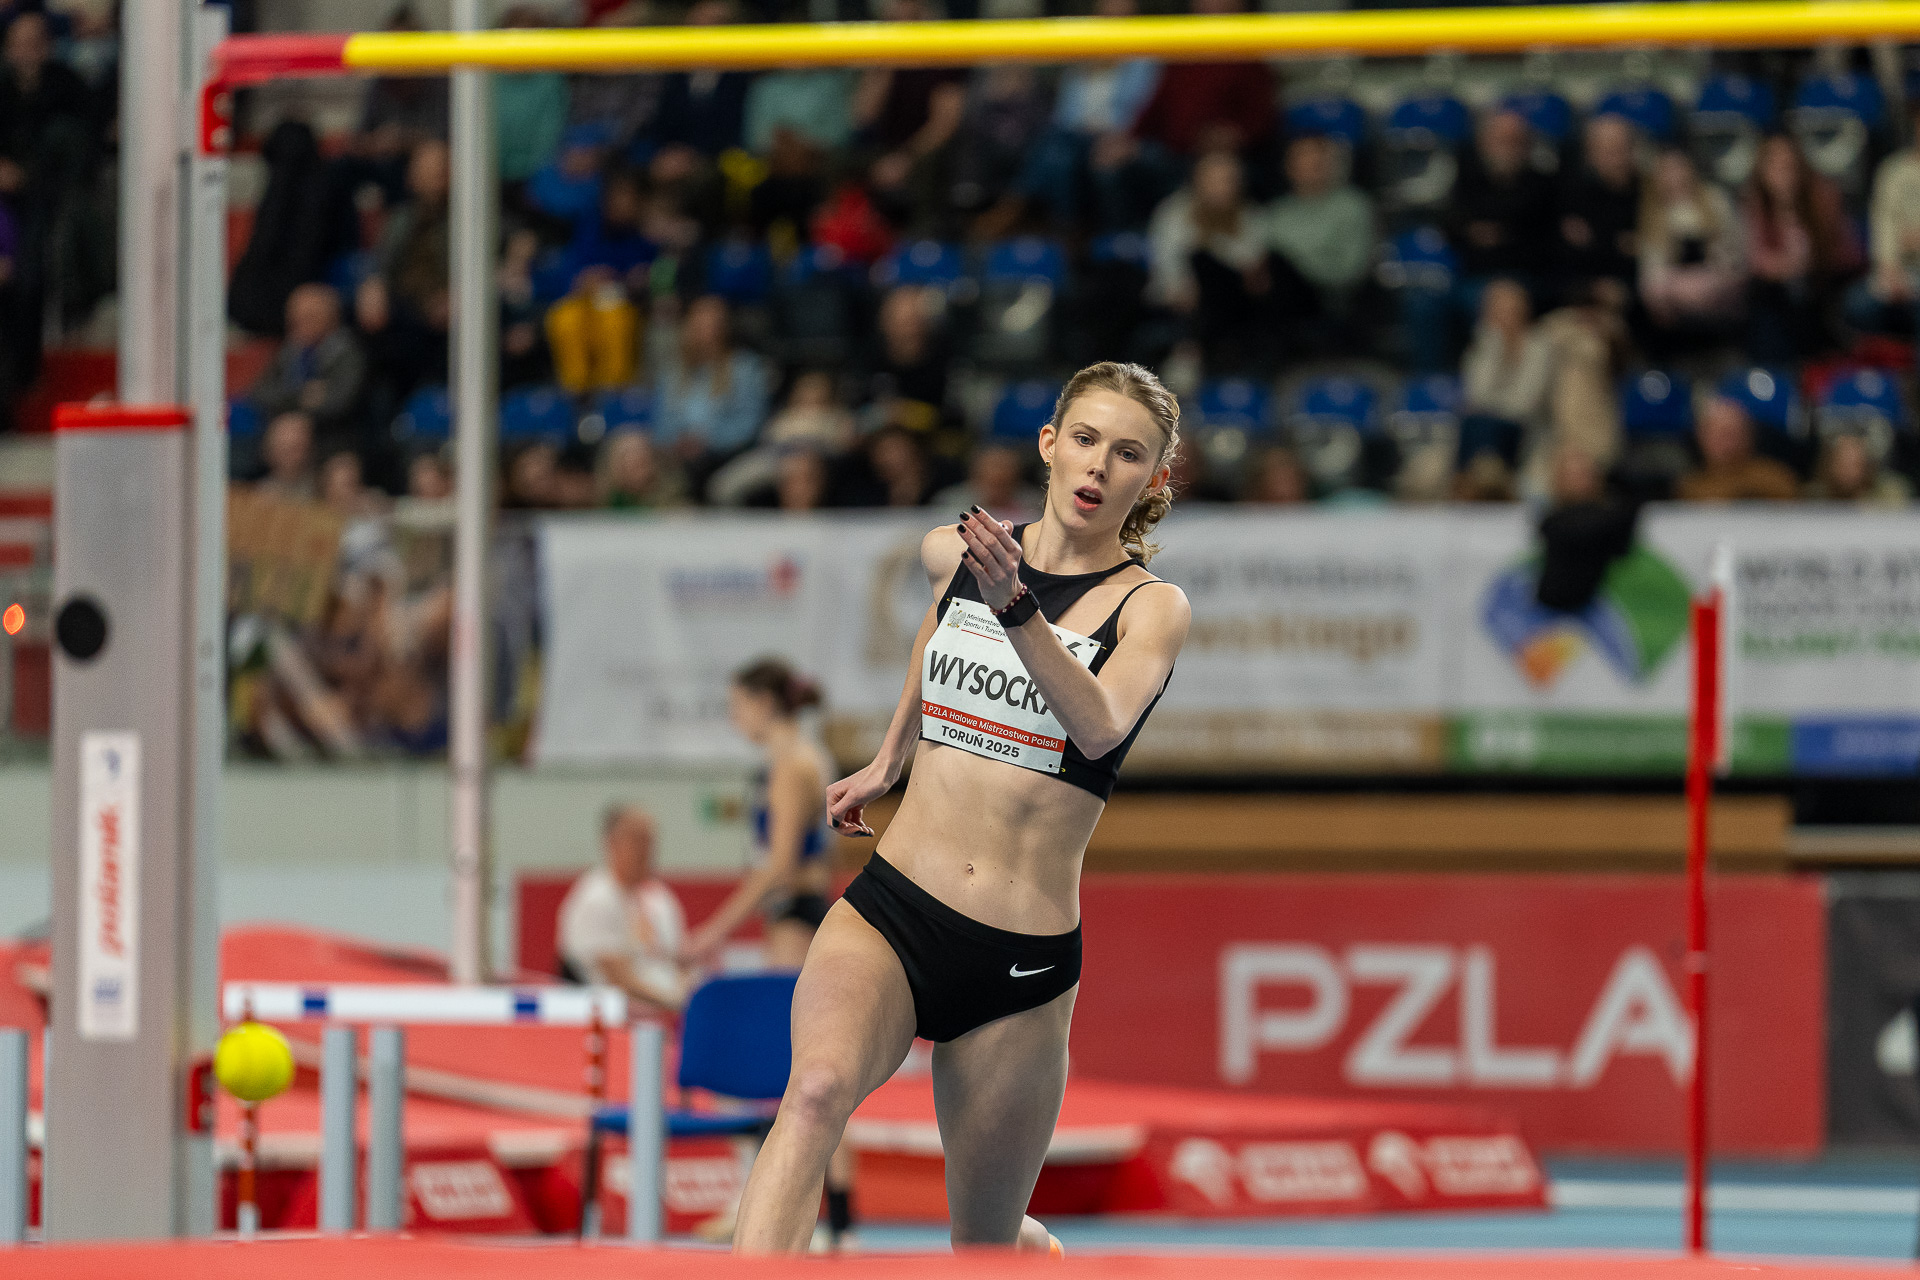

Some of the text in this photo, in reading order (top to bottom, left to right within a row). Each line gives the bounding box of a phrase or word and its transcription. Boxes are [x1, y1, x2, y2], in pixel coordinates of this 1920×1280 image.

[963, 619, 981, 631] Sportu
[966, 613, 1001, 628] Ministerstwo
[928, 650, 1050, 716] WYSOCK
[928, 704, 948, 718] PZLA
[949, 711, 978, 728] Halowe
[979, 720, 1030, 743] Mistrzostwa
[1030, 735, 1059, 750] Polski
[941, 724, 1020, 758] TORUŃ 2025
[1217, 942, 1697, 1088] PZLA
